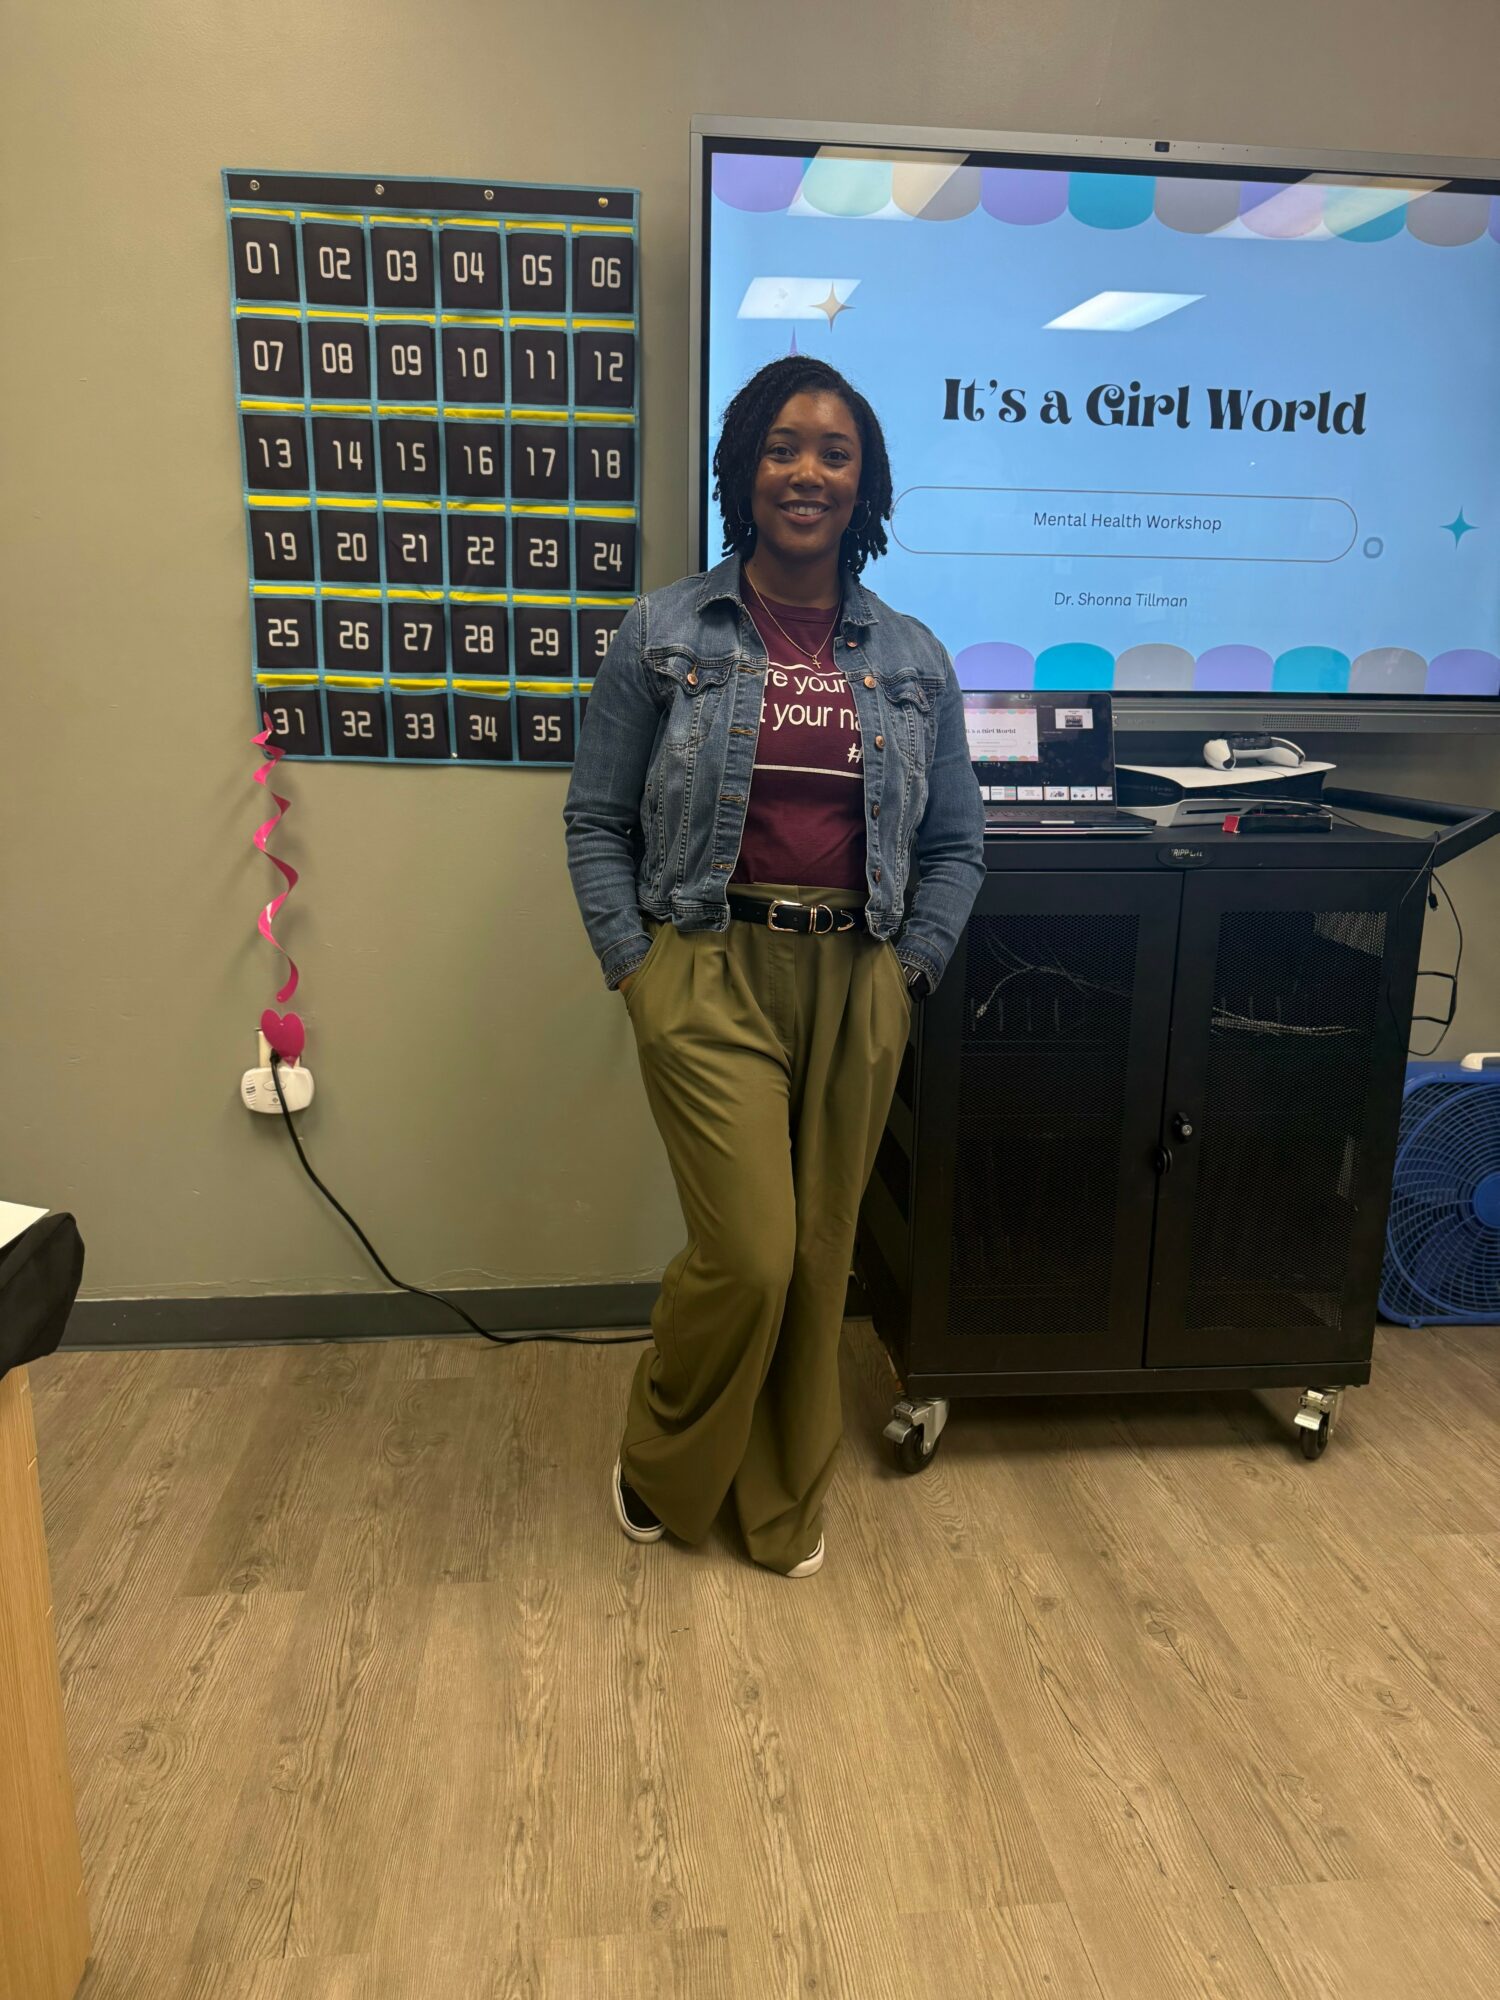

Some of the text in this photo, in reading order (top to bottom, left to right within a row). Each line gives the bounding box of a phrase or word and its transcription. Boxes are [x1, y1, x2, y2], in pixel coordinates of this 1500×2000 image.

[245, 241, 621, 288] 01 02 03 04 05 06
[253, 340, 623, 382] 07 08 09 10 11 12
[944, 378, 1367, 435] It's a Girl World
[258, 438, 621, 479] 13 14 15 16 17 18
[1033, 512, 1222, 534] Mental Health Workshop
[264, 531, 622, 572] 19 20 21 22 23 24
[1054, 592, 1188, 608] Dr. Shonna Tillman
[267, 618, 300, 647] 25
[339, 620, 369, 650] 26
[403, 622, 433, 651] 27
[465, 624, 494, 654] 28
[530, 627, 559, 656] 29
[794, 675, 848, 695] your
[273, 708, 561, 742] 31 32 33 34 35
[772, 703, 833, 731] your
